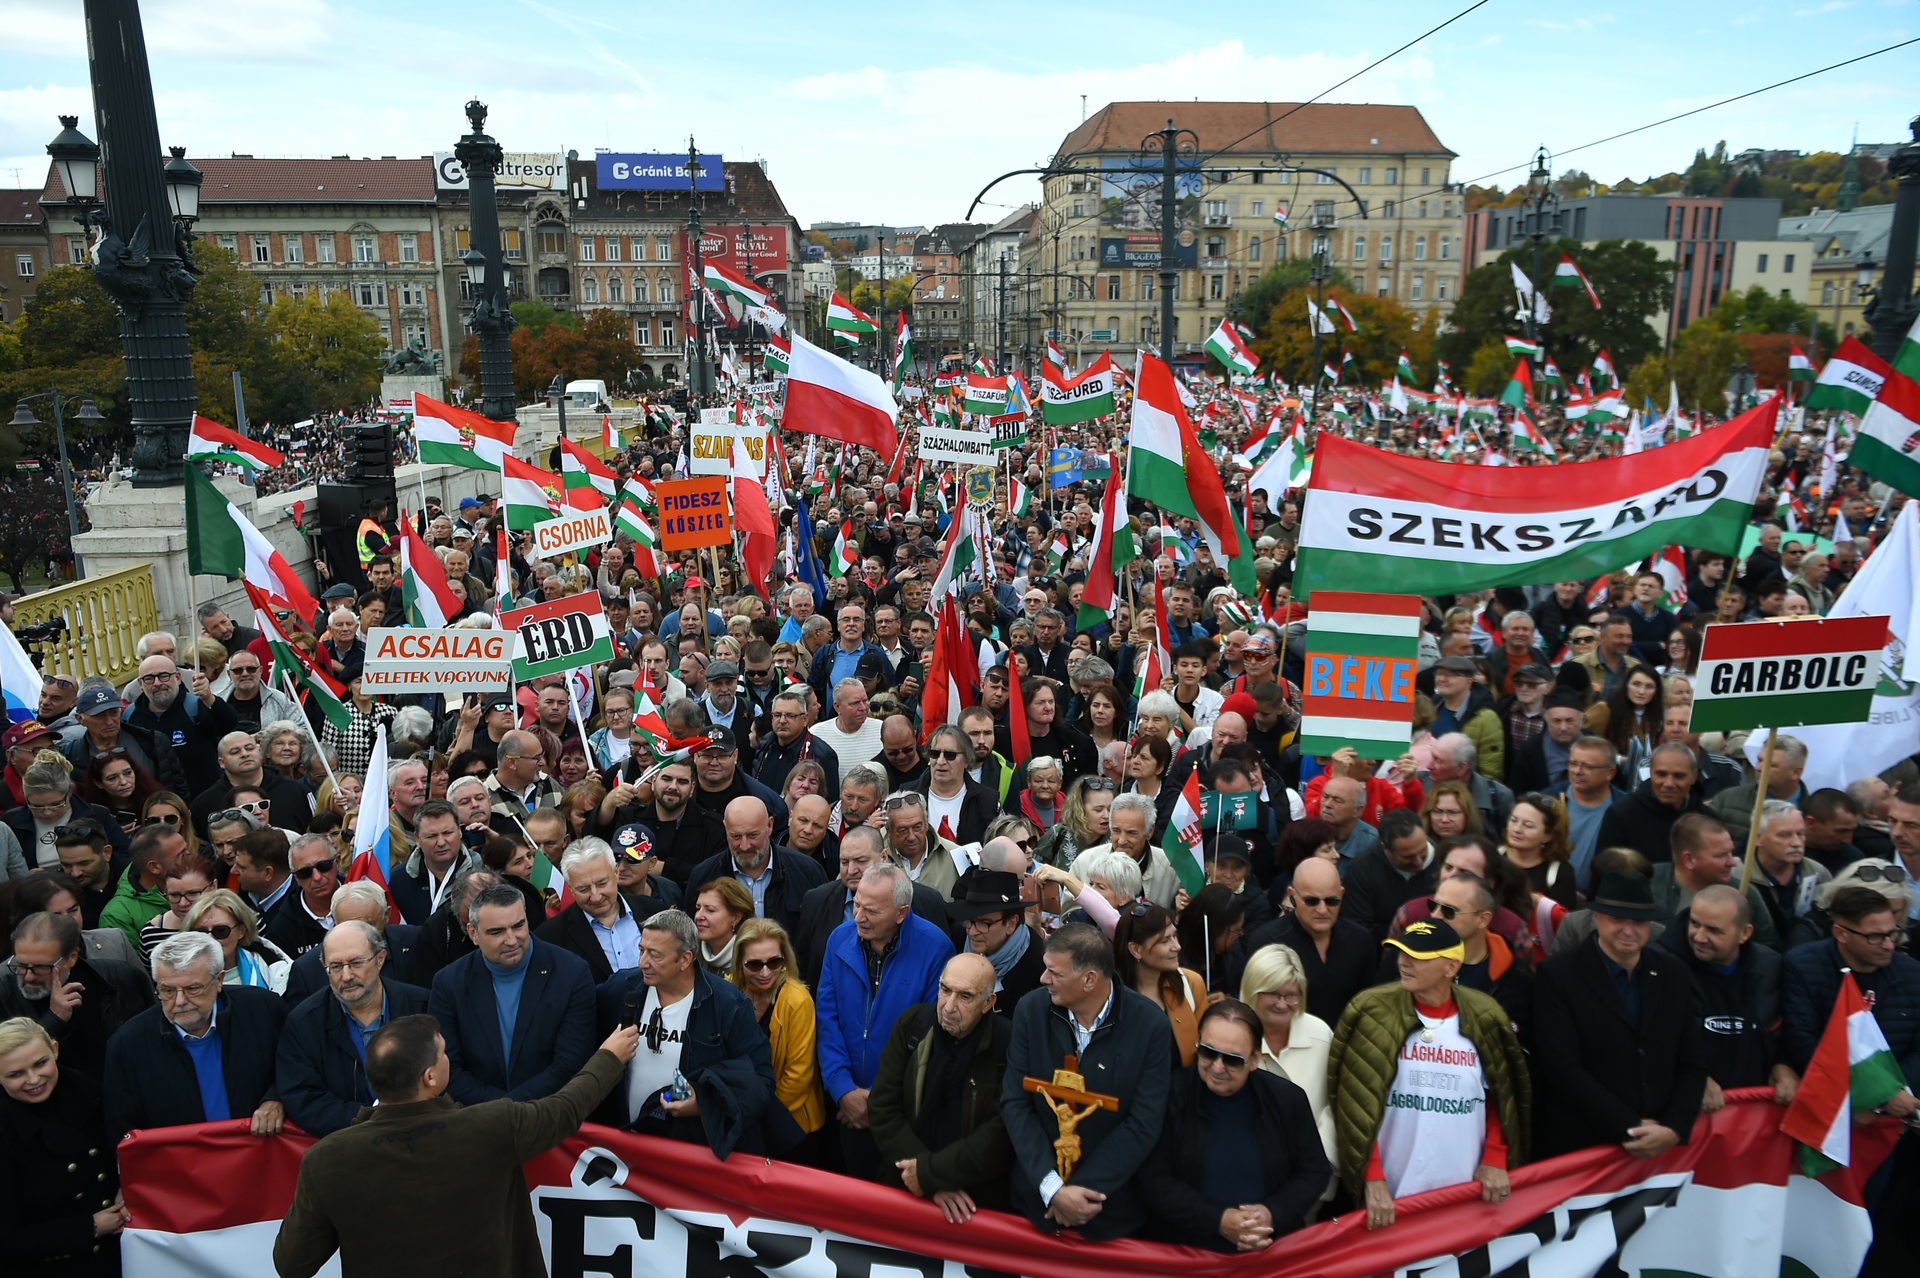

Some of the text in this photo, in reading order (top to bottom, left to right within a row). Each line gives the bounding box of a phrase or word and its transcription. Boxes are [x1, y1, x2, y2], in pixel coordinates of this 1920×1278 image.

[632, 165, 673, 177] Gránit
[995, 419, 1020, 442] ÉRD
[923, 434, 995, 456] SZÁZHALOMBATTA
[664, 491, 722, 511] FIDESZ
[539, 514, 609, 551] CSORNA
[377, 635, 504, 659] ACSALAG
[518, 612, 594, 664] ÉRD
[364, 670, 509, 684] VELETEK VAGYUNK
[1309, 654, 1412, 703] BÉKE
[1710, 654, 1867, 696] GARBOLC
[1409, 1070, 1462, 1092] HELYETT
